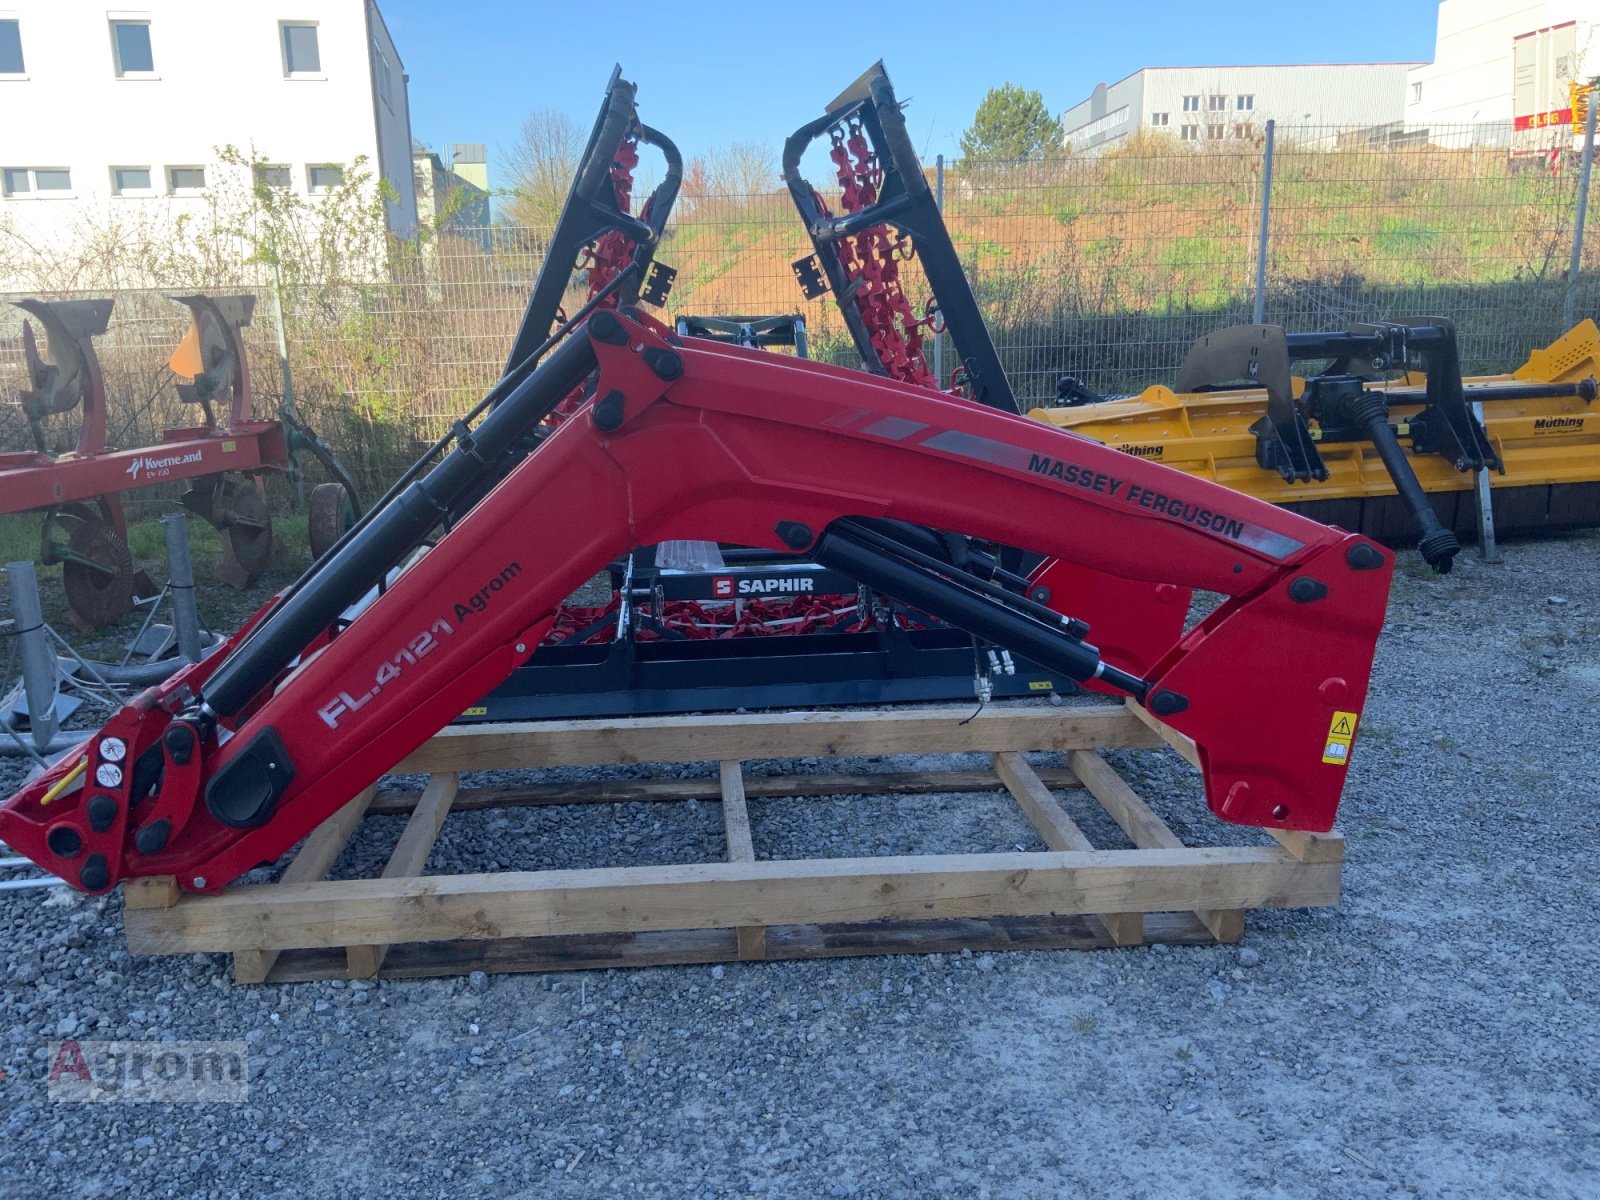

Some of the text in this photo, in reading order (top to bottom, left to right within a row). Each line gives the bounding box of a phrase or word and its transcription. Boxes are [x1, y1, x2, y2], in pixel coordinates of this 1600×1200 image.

[1116, 443, 1163, 457] üthing
[1028, 454, 1245, 539] MASSEY FERGUSON
[738, 578, 814, 594] SAPHIR
[317, 561, 523, 729] FL.4121 Agrom
